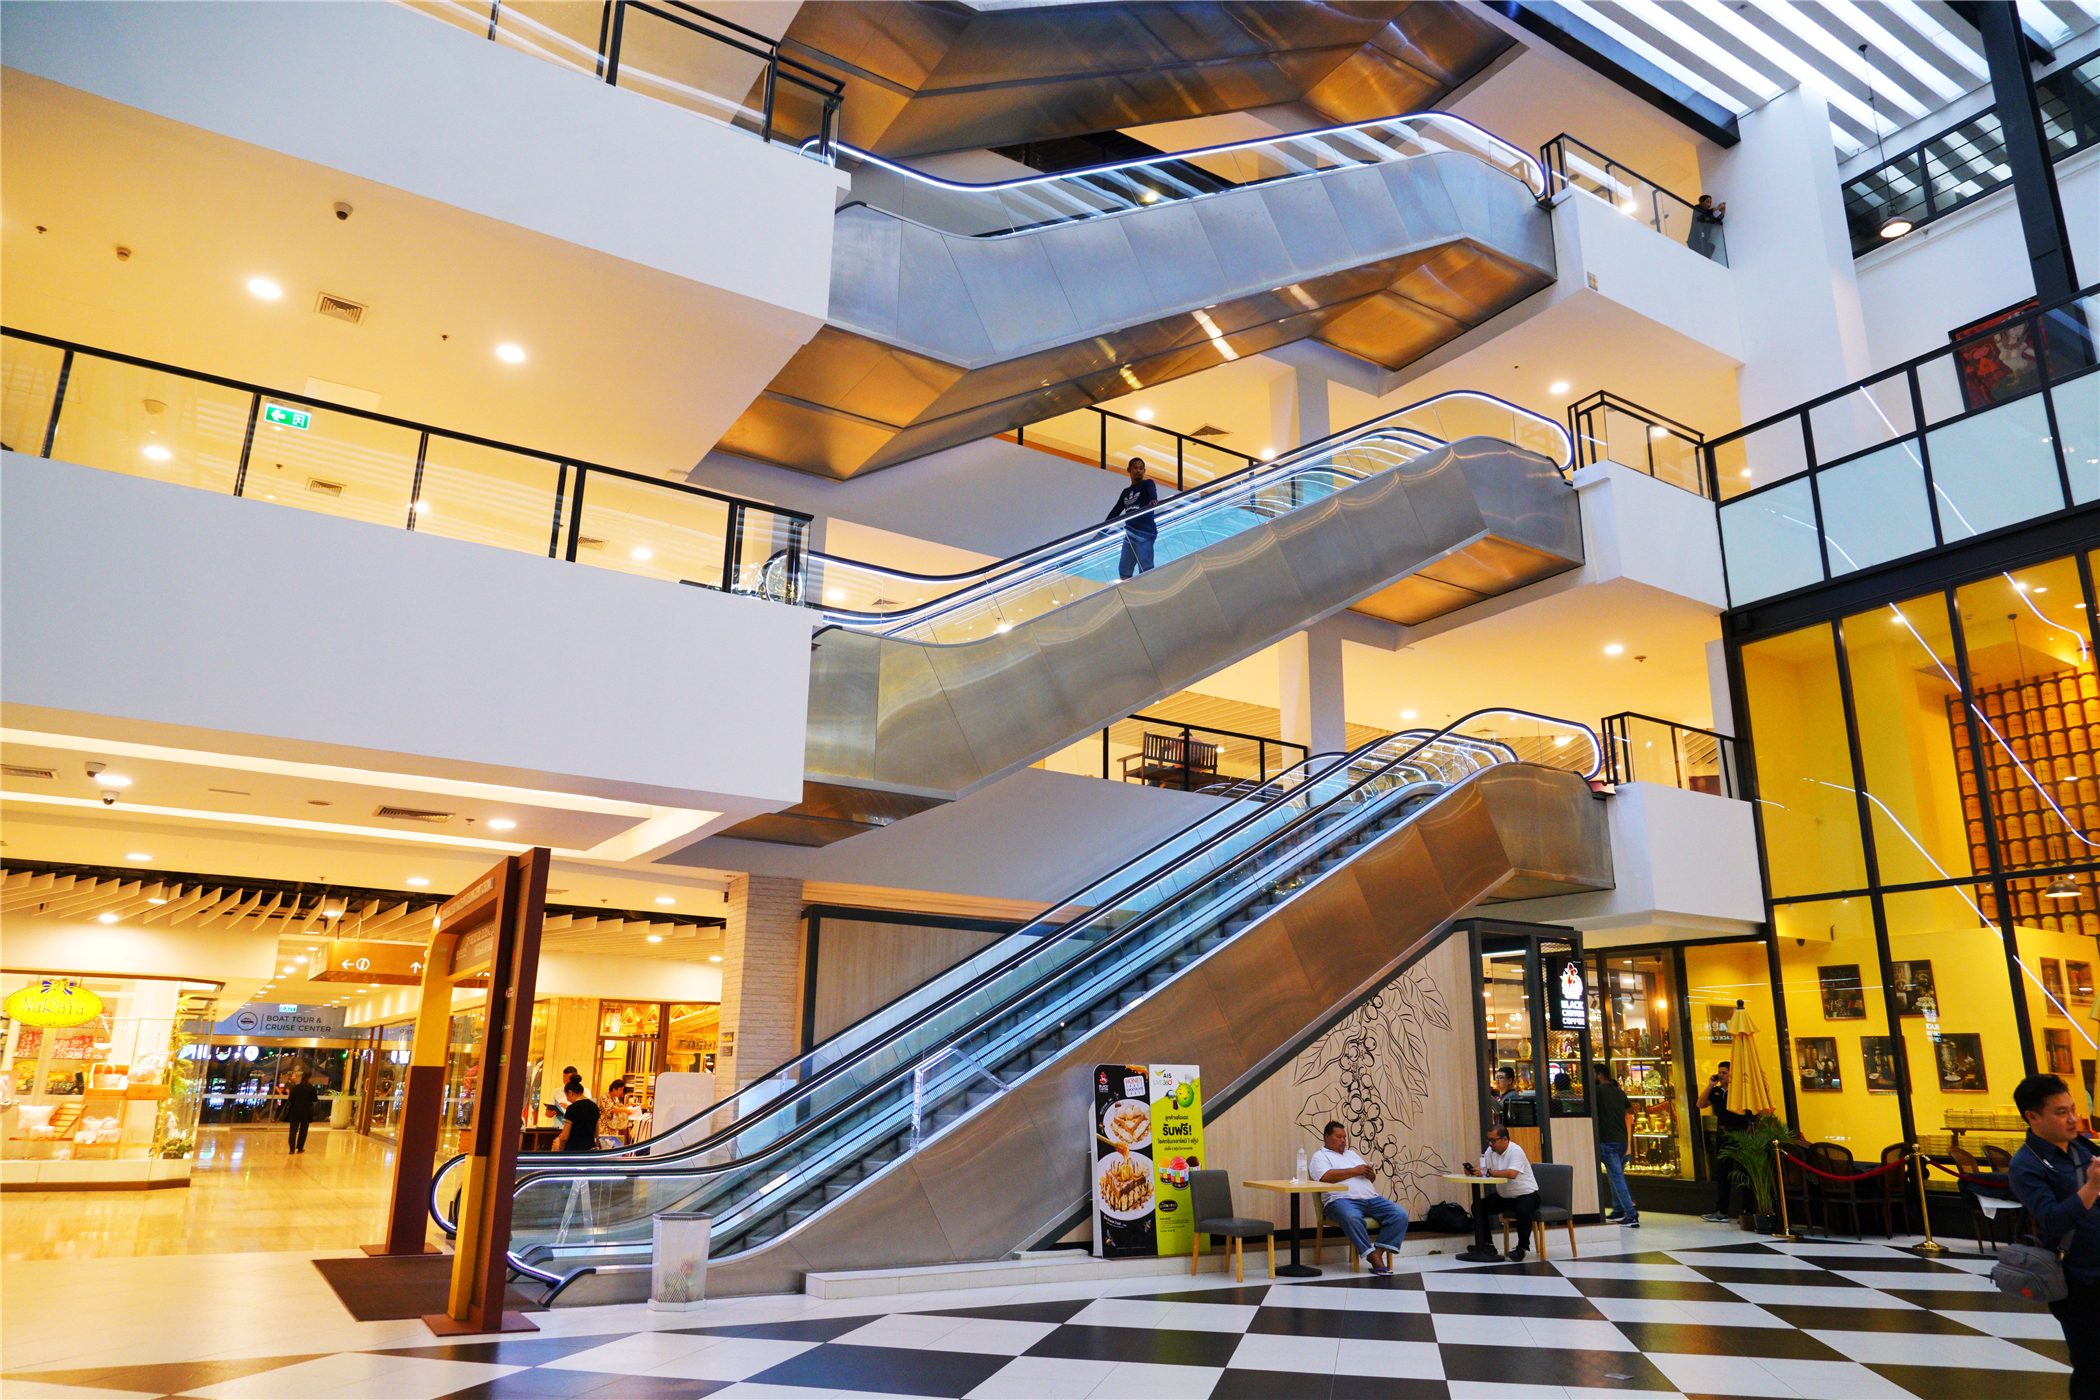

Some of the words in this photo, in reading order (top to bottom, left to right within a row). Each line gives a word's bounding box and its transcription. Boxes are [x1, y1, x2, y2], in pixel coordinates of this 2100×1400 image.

[21, 996, 86, 1015] NaRaYa
[1560, 1000, 1584, 1010] BLACK
[292, 1016, 314, 1024] TOUR
[1562, 1017, 1586, 1025] COFFEE
[265, 1024, 296, 1032] CRUISE
[679, 1039, 717, 1051] FASHI
[1162, 1122, 1192, 1136] รับฟรี!
